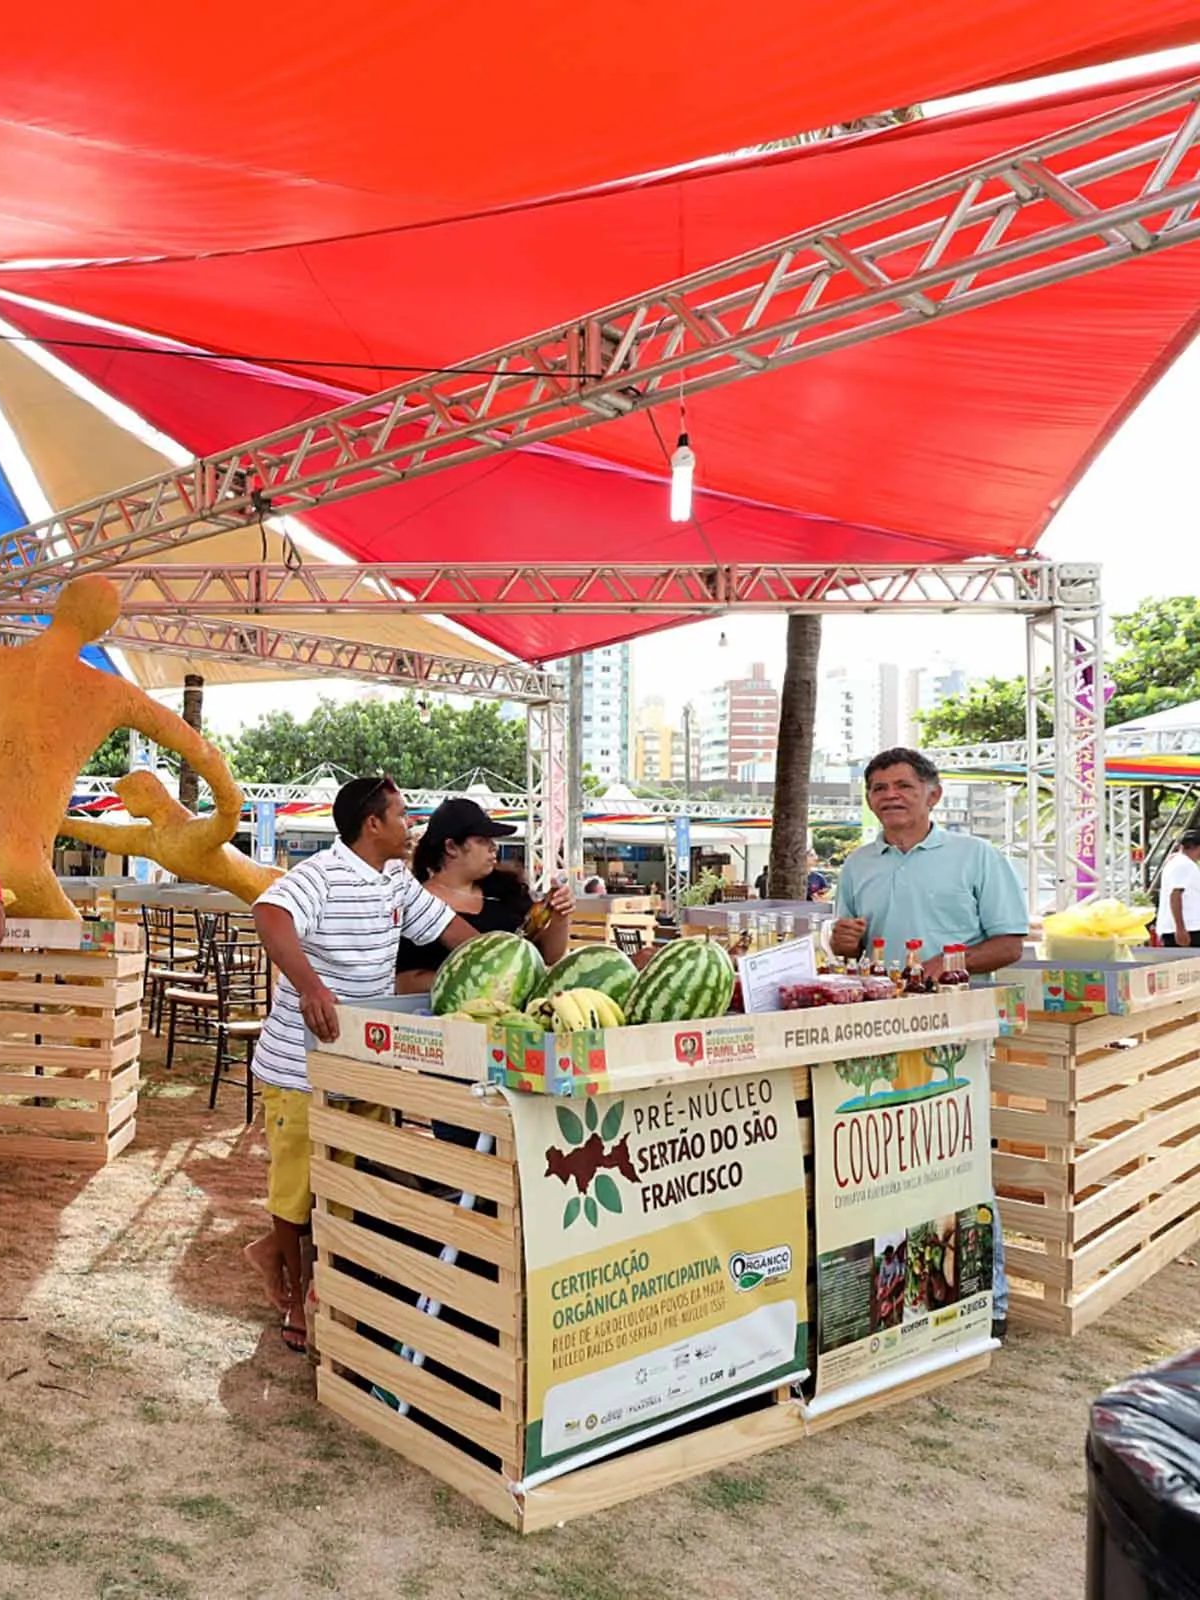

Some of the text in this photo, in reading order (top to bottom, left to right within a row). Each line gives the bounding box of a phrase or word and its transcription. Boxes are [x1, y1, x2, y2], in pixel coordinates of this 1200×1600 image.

[393, 1041, 445, 1060] FAMILIAR
[706, 1042, 755, 1058] FAMILIAR
[784, 1012, 950, 1049] FEIRA AGROECOLOGICA
[633, 1079, 773, 1134] PRÉ-NÚCLEO
[637, 1109, 778, 1173] SERTÃO DO SÃO
[833, 1094, 974, 1188] COOPERVIDA
[641, 1161, 743, 1214] FRANCISCO
[551, 1249, 650, 1300] CERTIFICAÇÃO
[732, 1251, 790, 1278] ORGÂNICO
[552, 1255, 722, 1330] ORGÂNICA PARTICIPATIVA
[552, 1279, 726, 1354] REDE DE AGROECOLOGIA POVOS DA MATA
[616, 1332, 628, 1349] DO
